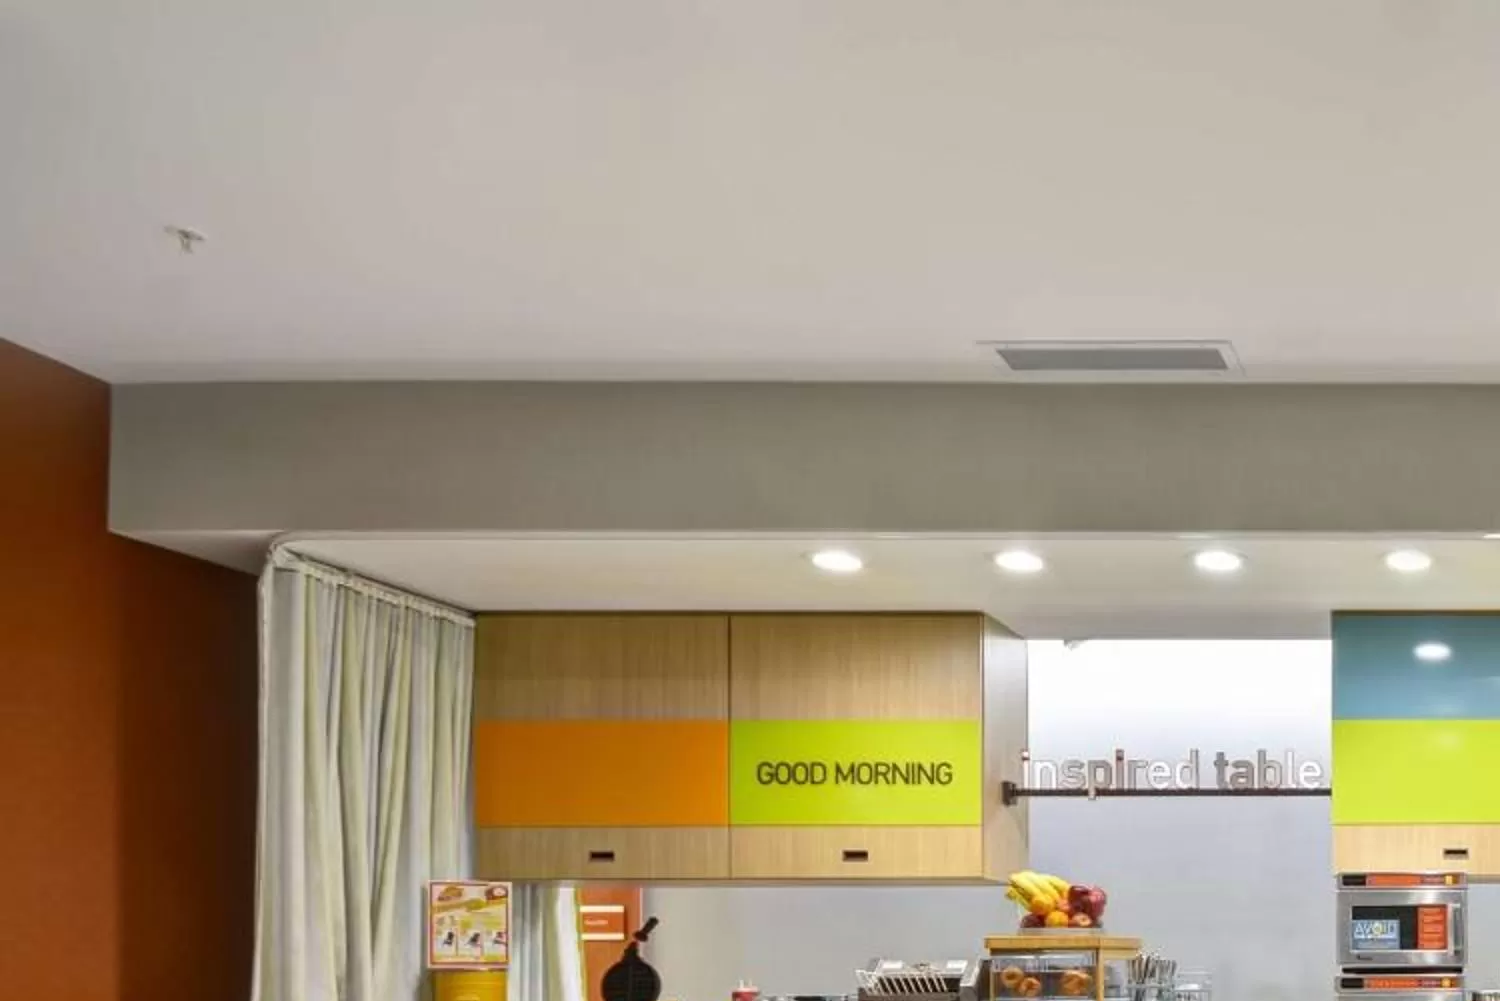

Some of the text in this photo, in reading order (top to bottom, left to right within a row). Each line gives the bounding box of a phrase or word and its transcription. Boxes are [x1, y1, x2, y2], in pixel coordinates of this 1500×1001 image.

[757, 761, 953, 785] GOOD MORNING
[1021, 749, 1322, 800] inspired table
